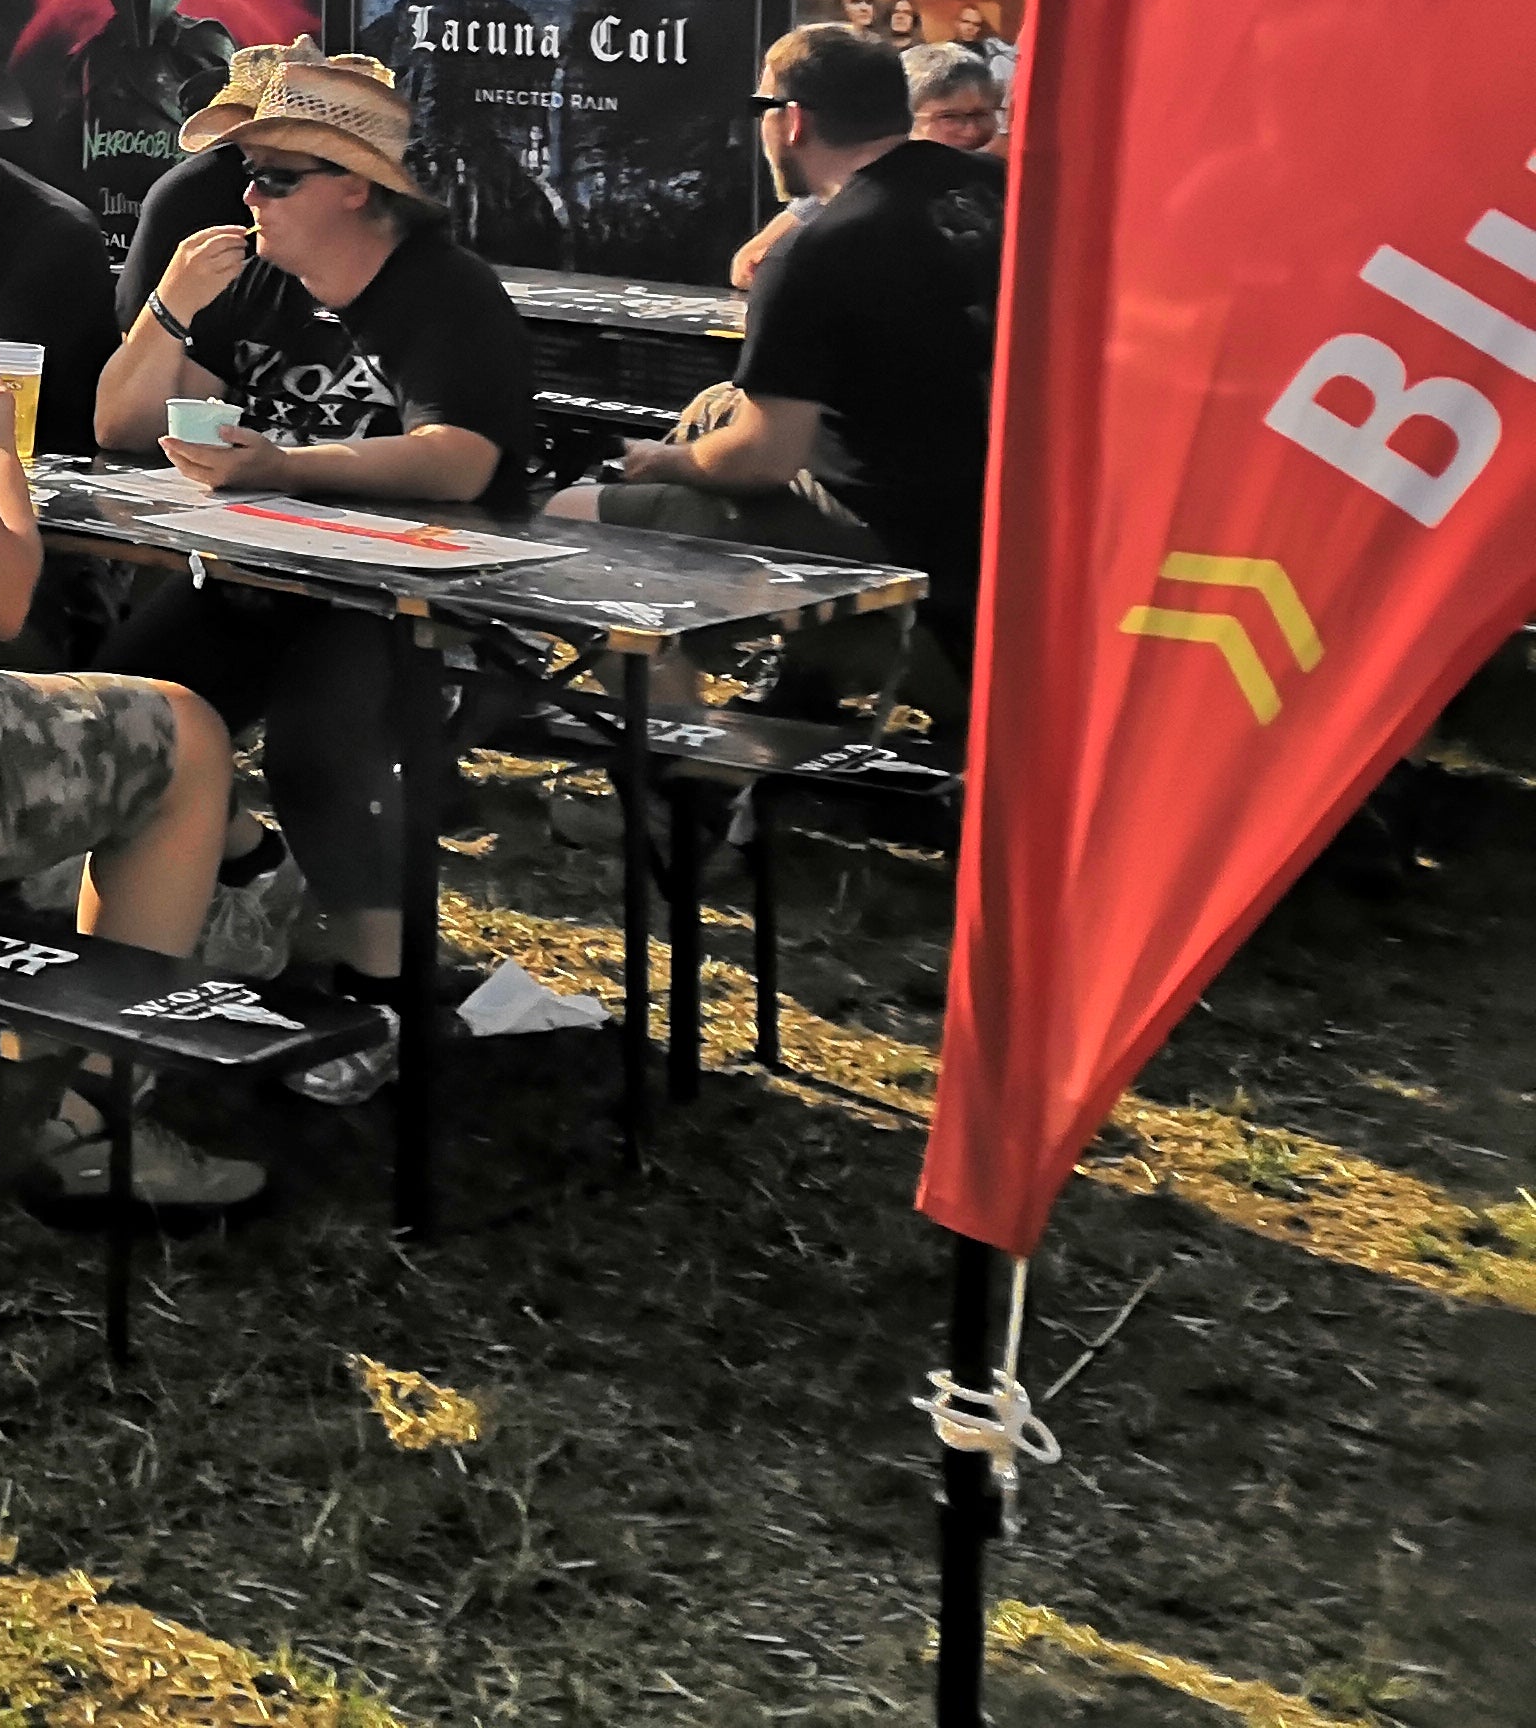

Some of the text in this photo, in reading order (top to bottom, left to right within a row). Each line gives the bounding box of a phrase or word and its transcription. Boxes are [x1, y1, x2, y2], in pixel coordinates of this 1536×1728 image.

[408, 5, 688, 65] Lacuna Coil
[474, 88, 618, 111] INFECTED RAIN
[532, 390, 681, 421] FASTE
